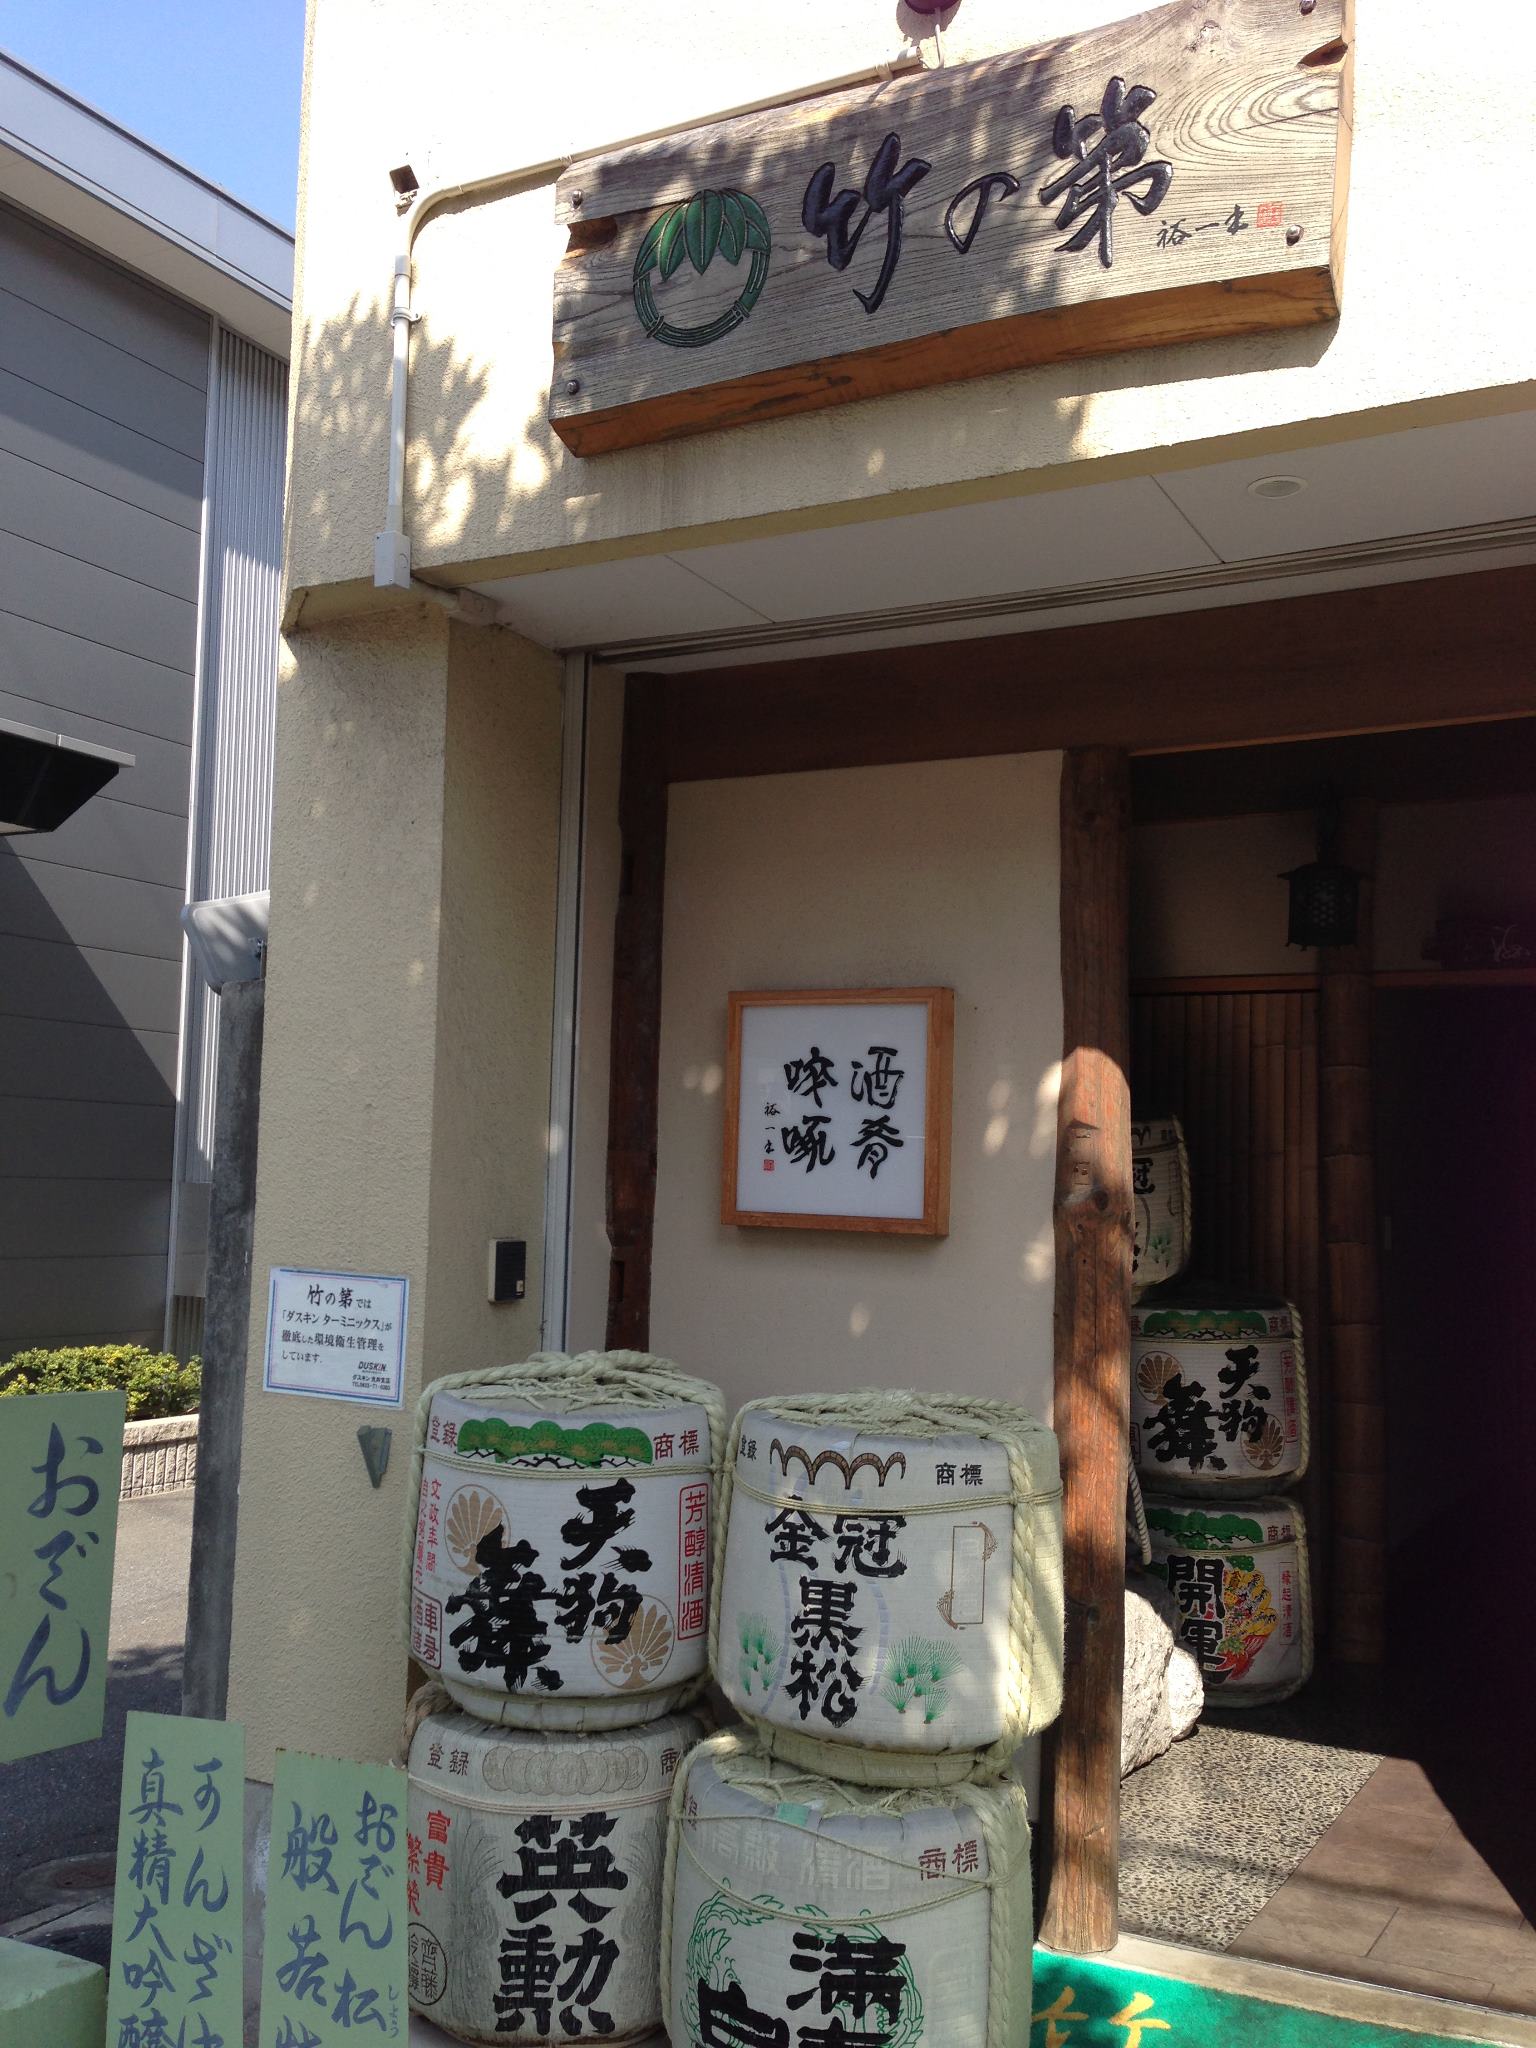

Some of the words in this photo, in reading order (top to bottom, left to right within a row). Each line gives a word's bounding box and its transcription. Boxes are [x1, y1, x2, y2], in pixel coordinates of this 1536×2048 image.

[307, 1283, 372, 1309] 竹の第では
[358, 1361, 387, 1372] DUSKIN
[653, 1429, 700, 1460] 商標
[935, 1462, 984, 1486] 商標
[784, 1575, 872, 1729] 黒松
[427, 1742, 470, 1776] 登録
[423, 1809, 451, 1891] 富貴
